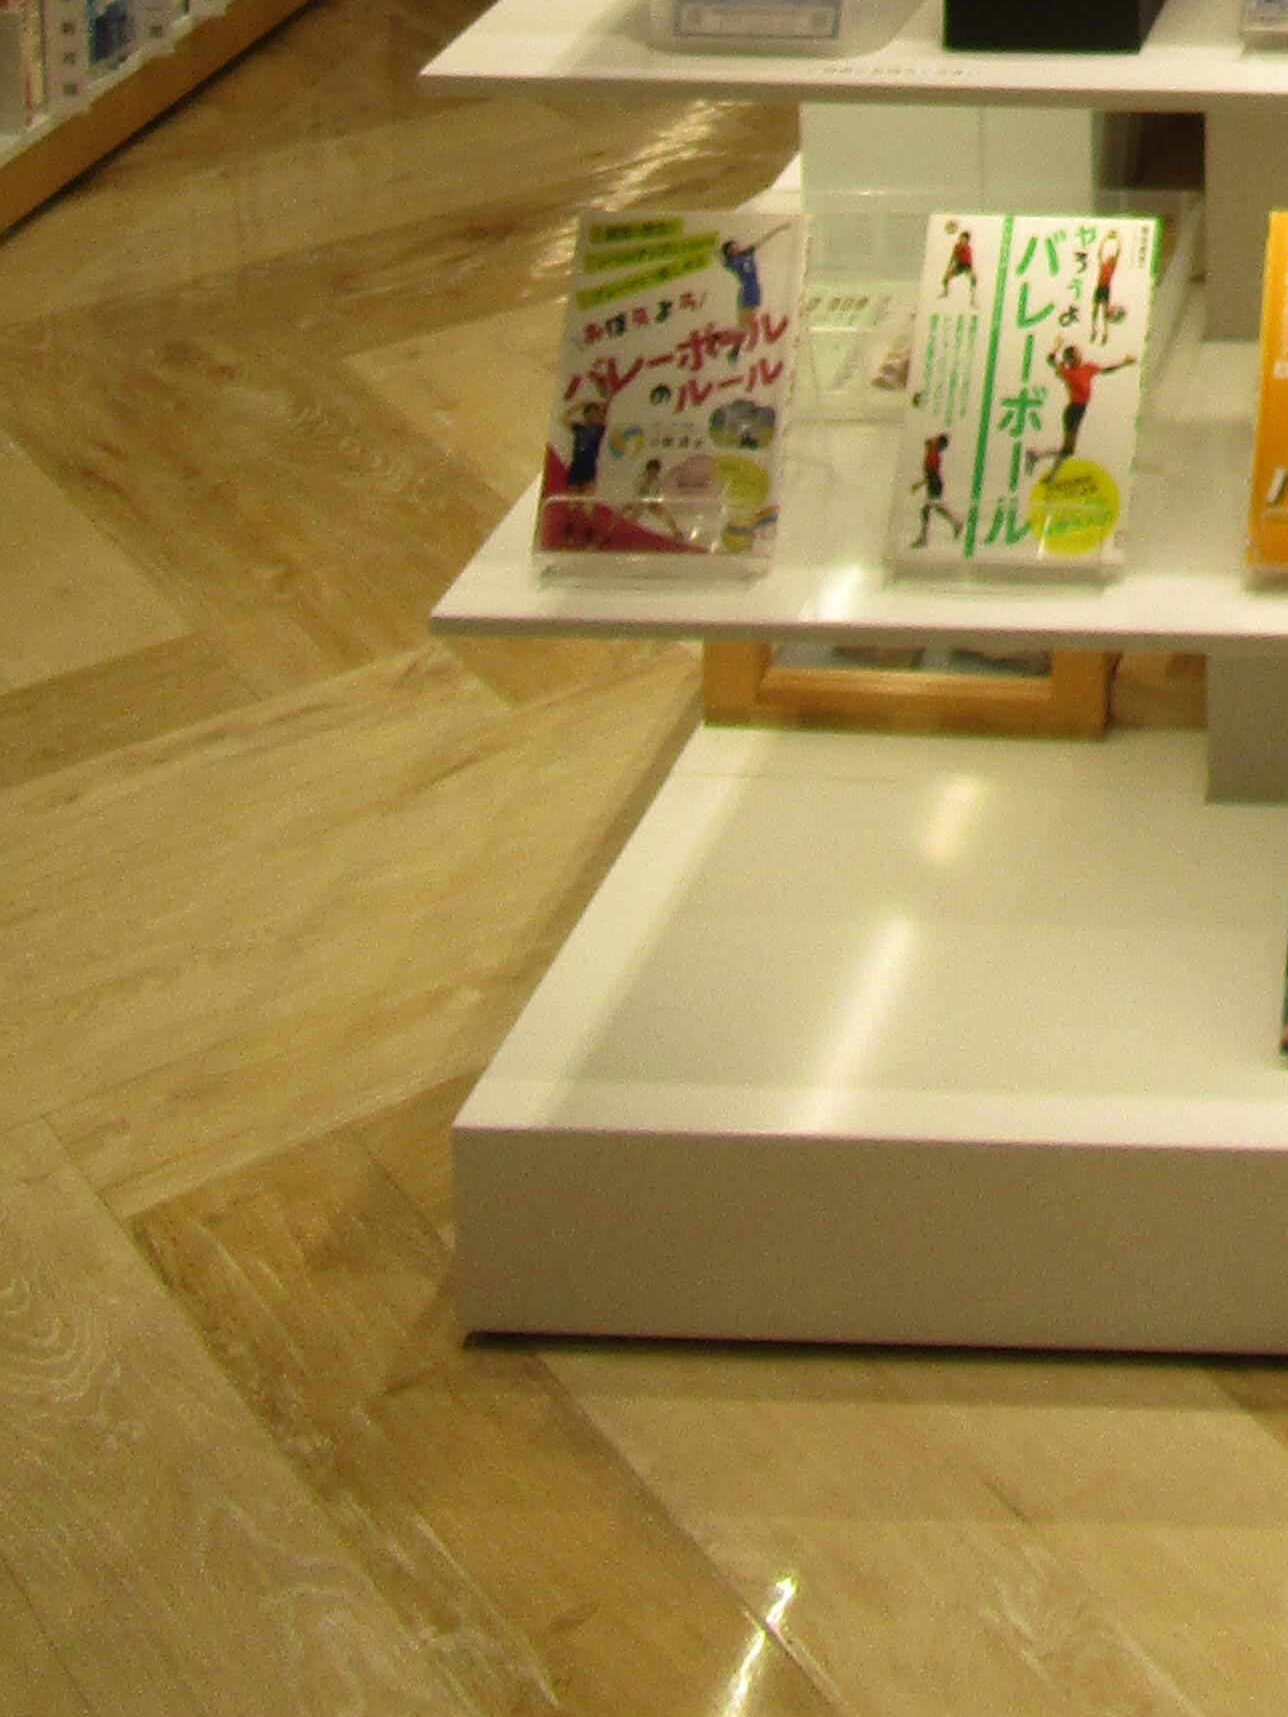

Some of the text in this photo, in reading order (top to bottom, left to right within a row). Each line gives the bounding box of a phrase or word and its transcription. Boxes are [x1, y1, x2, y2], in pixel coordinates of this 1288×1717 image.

[984, 229, 1067, 549] バレーボール
